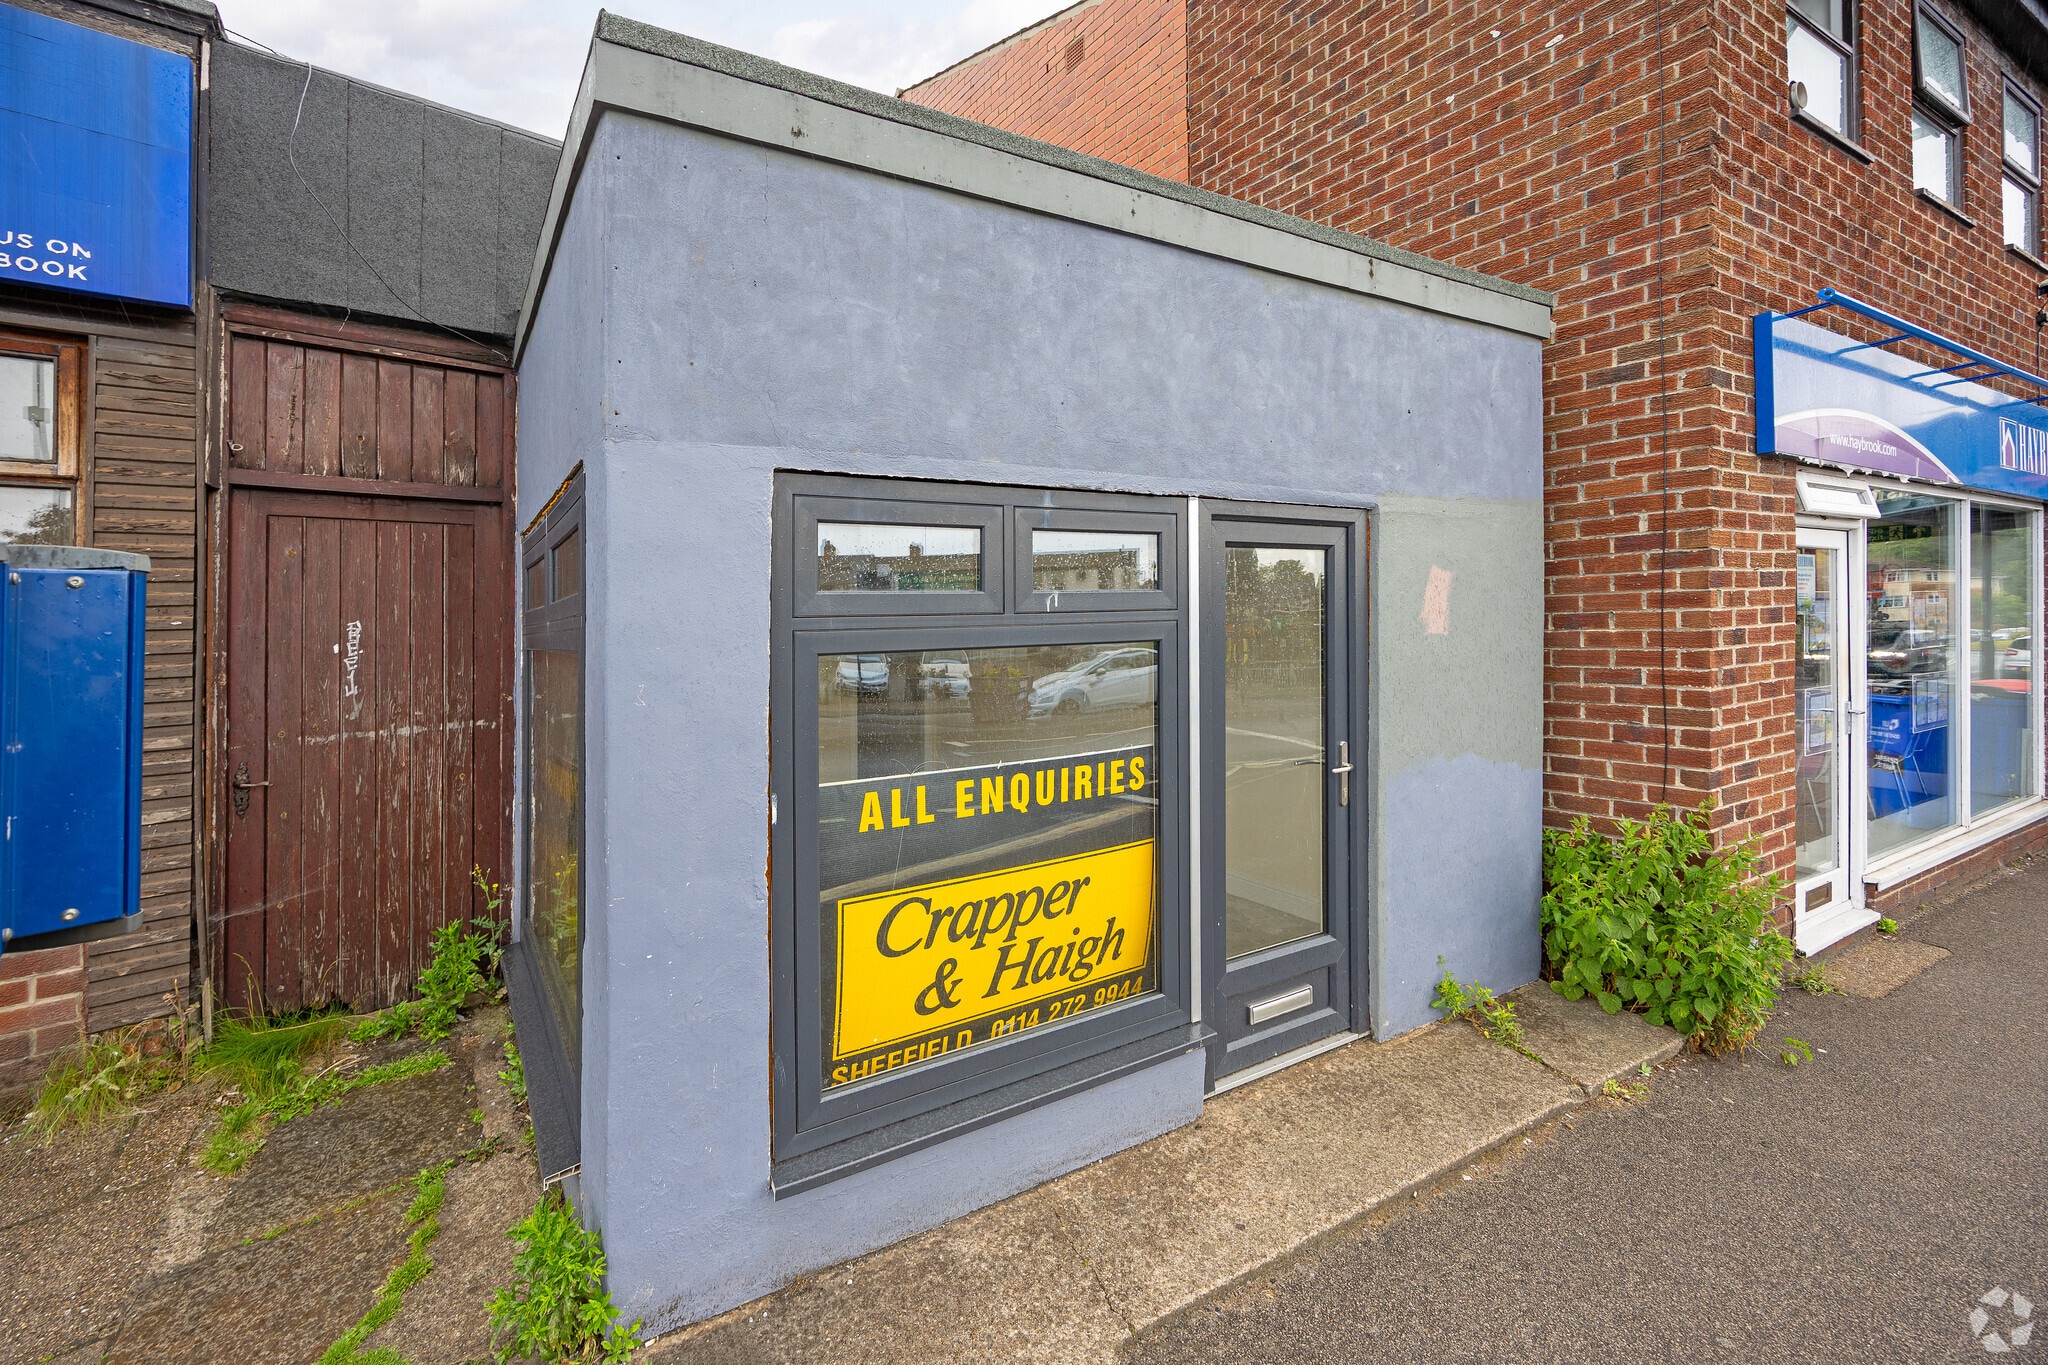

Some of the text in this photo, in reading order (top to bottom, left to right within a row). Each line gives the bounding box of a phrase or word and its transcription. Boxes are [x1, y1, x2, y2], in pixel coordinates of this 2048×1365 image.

[45, 239, 92, 259] ON
[1829, 433, 1897, 457] www.haybrook.com
[858, 756, 1146, 833] ALL ENQUIRIES
[876, 876, 1091, 958] Crapper
[914, 916, 1126, 1017] & Haigh
[990, 1007, 1039, 1037] 0114
[1049, 993, 1084, 1018] 272
[1093, 975, 1143, 1007] 9944
